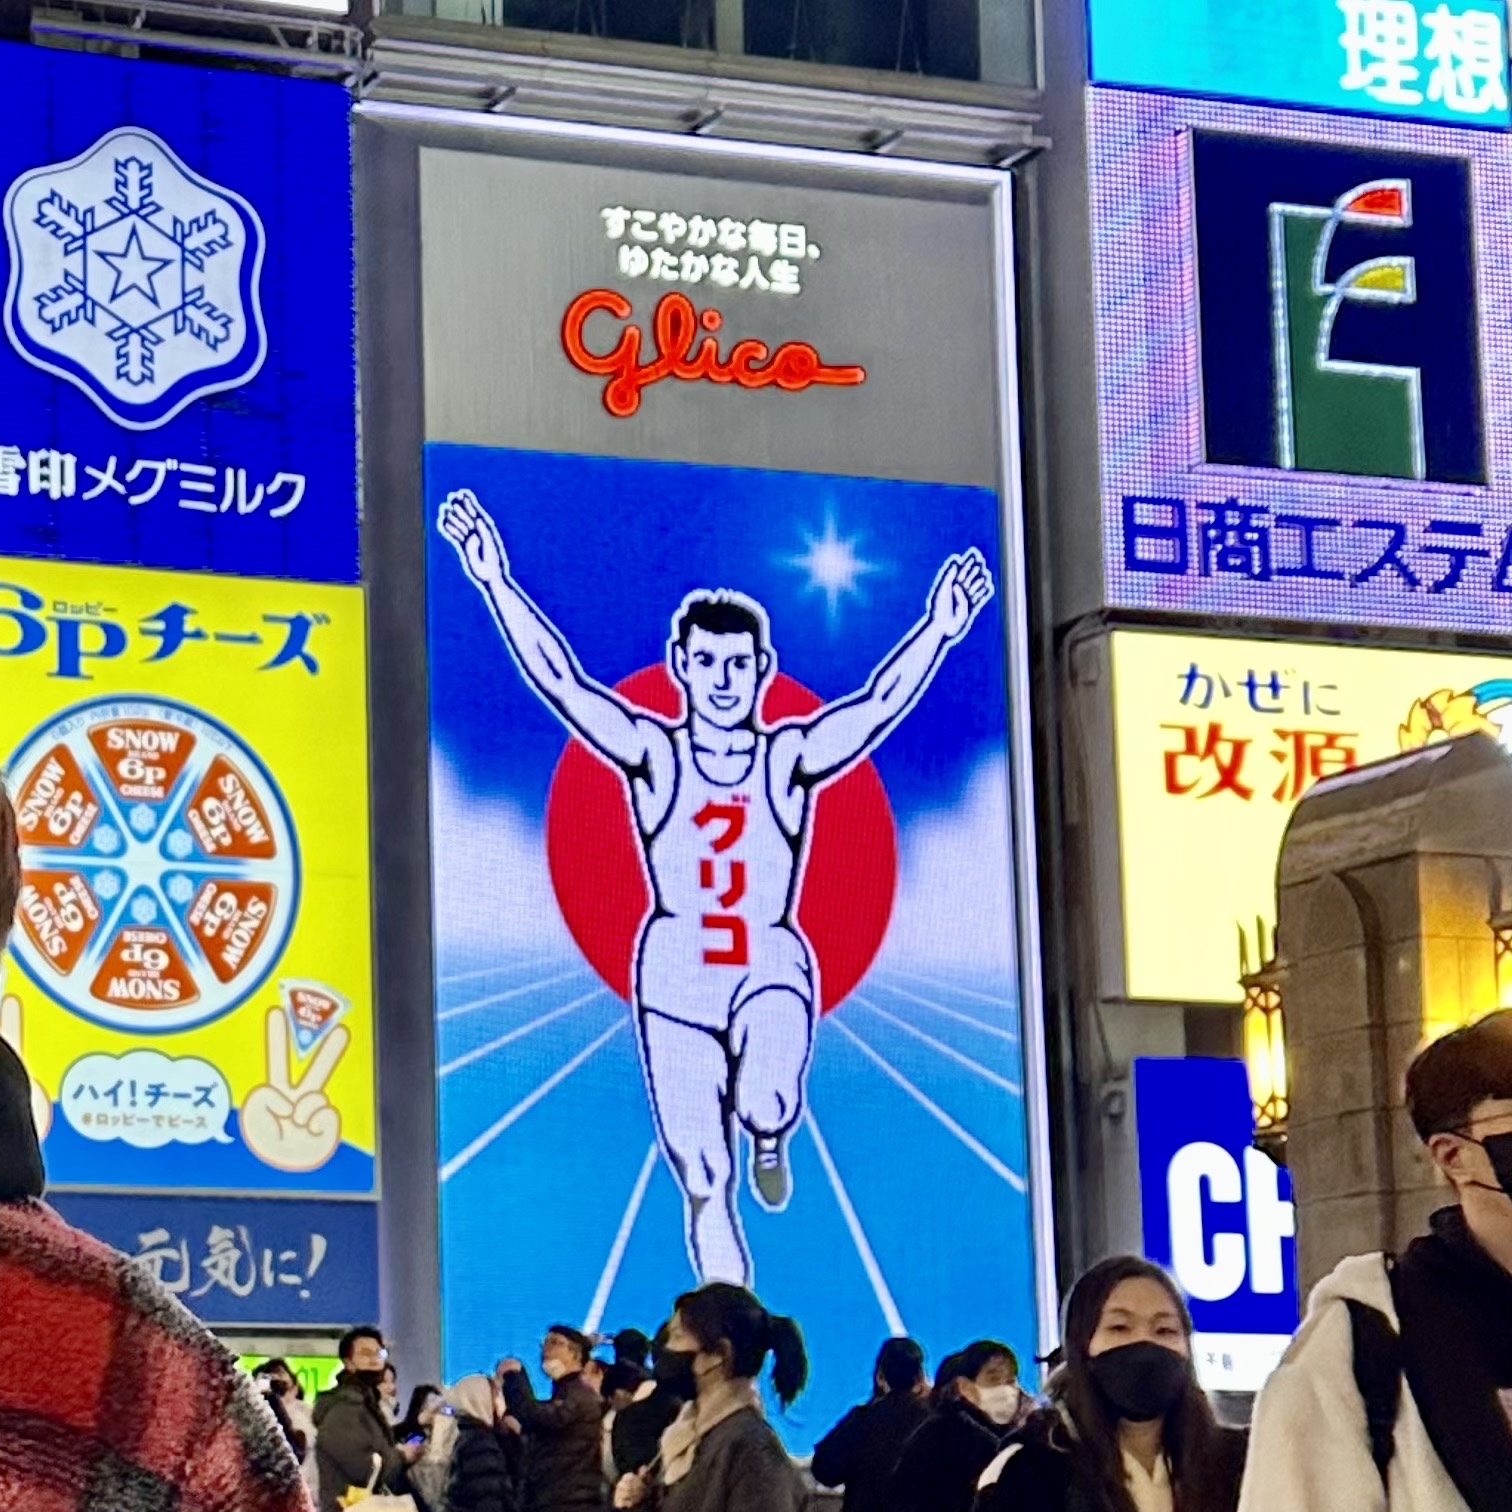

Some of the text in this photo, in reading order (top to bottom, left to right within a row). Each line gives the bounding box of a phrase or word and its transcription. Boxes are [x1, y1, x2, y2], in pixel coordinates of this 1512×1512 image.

[1338, 0, 1508, 113] 理想
[618, 244, 801, 294] ゆたかな人生
[561, 288, 866, 419] Glico
[1176, 662, 1342, 717] かぜに
[106, 727, 180, 753] SNOW
[1159, 721, 1360, 803] 改源
[18, 756, 66, 832] SNOW
[217, 772, 270, 844] SNOW
[692, 794, 750, 966] グリコ
[20, 885, 68, 958] SNOW
[222, 895, 268, 971] SNOW
[107, 977, 181, 1001] SNOW
